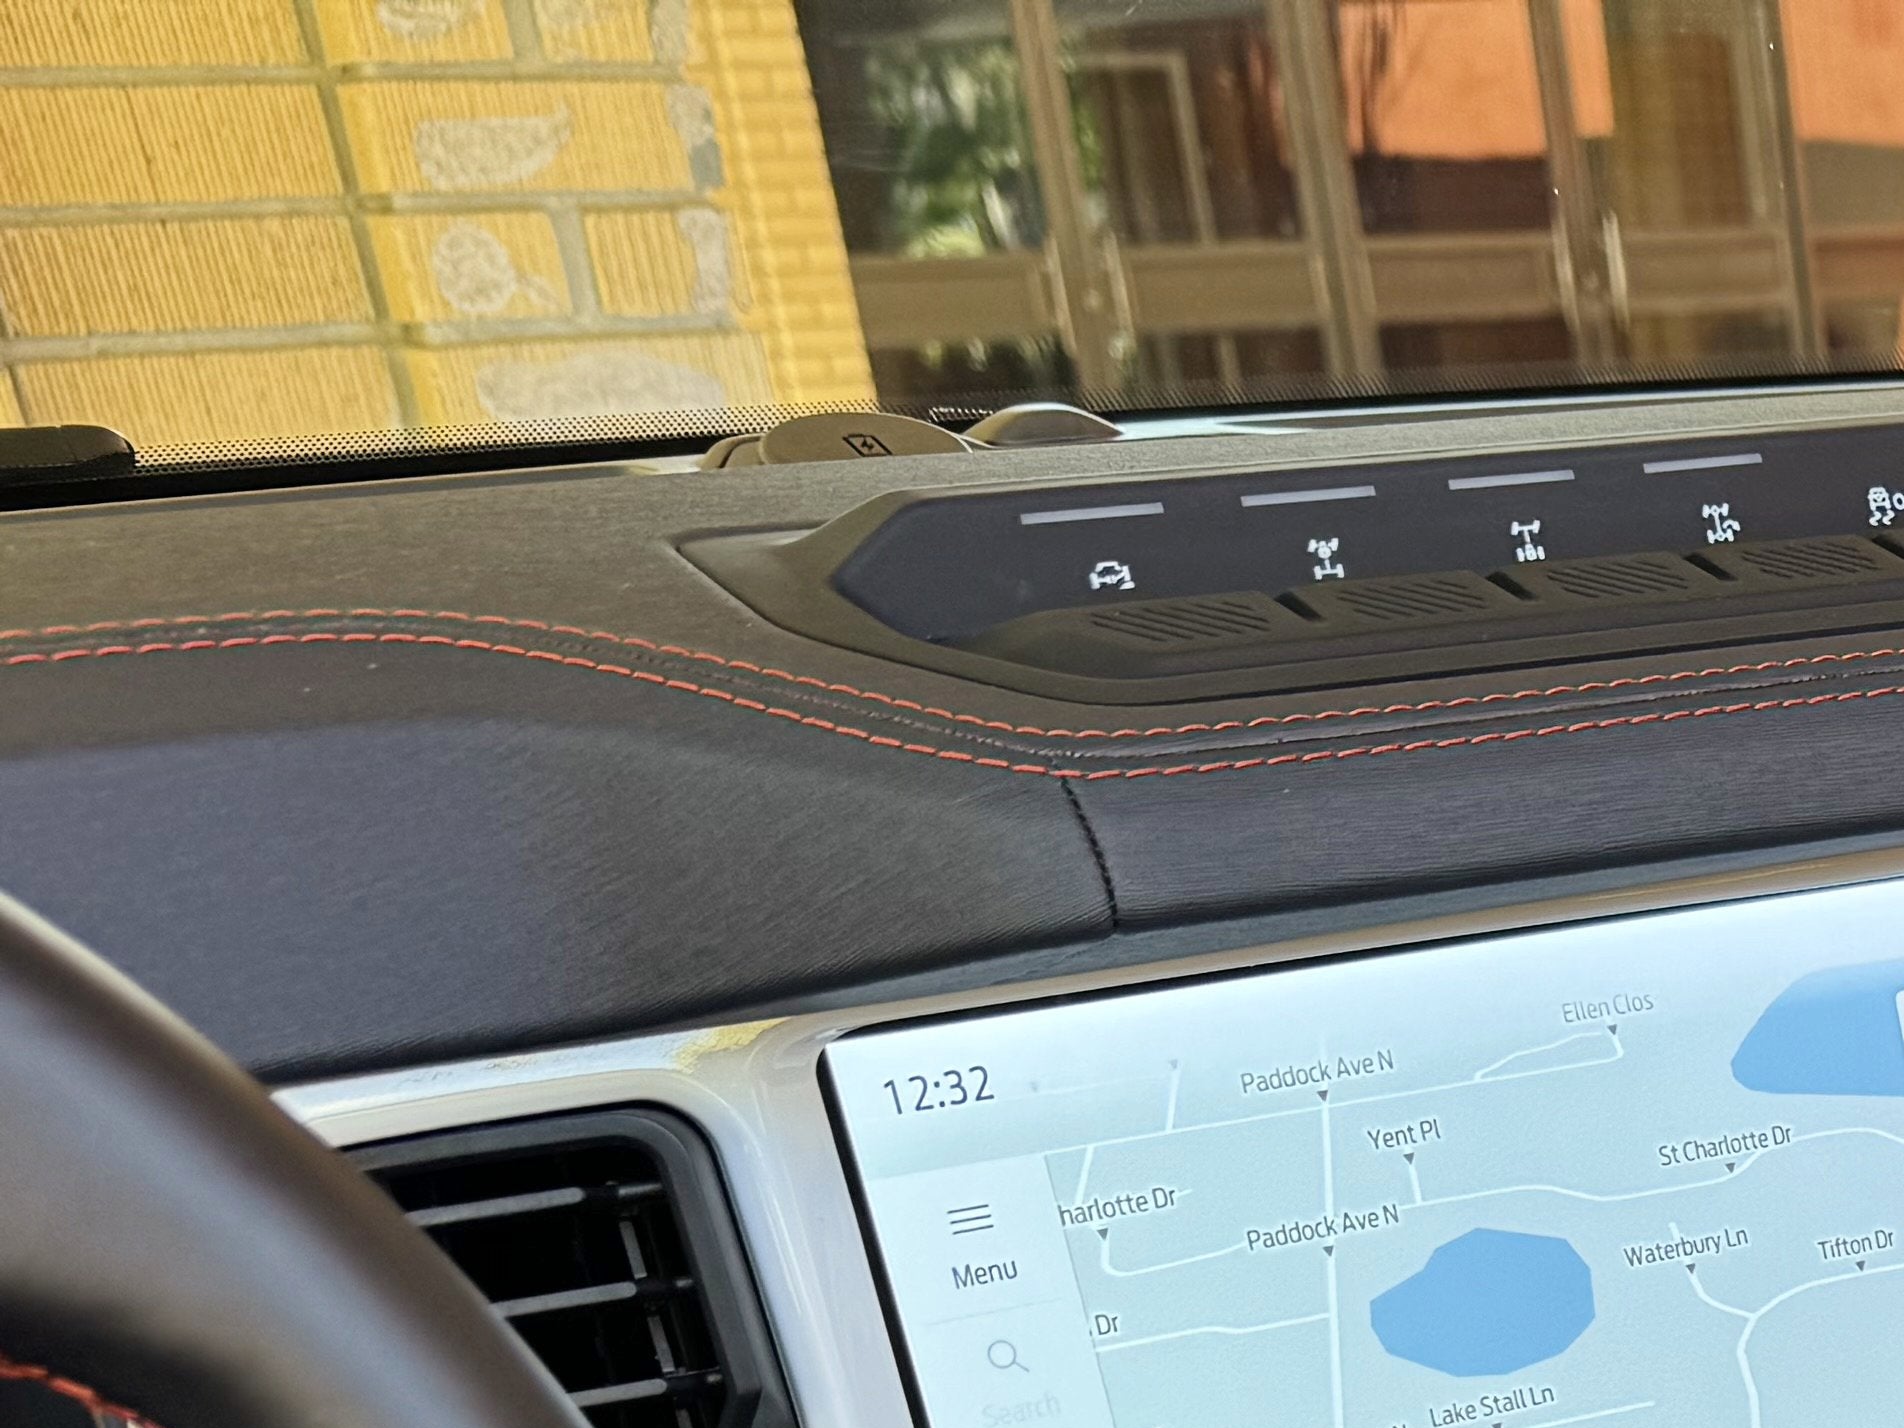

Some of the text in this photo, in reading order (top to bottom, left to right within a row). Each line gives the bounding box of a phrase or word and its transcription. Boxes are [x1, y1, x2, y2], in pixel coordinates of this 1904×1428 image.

[1562, 996, 1608, 1025] Ellen
[882, 1064, 996, 1117] 12:32
[1240, 1050, 1395, 1095] Paddock Ave N
[1367, 1119, 1442, 1151] Yent Pl
[1658, 1123, 1793, 1168] St Charlotte Dr
[1057, 1186, 1176, 1226] harlotte Dr
[1246, 1203, 1400, 1252] Paddock Ave N
[1817, 1227, 1896, 1260] Tifton Dr
[1623, 1226, 1750, 1271] Waterbury Ln
[952, 1257, 1019, 1291] Menu
[1094, 1313, 1119, 1336] Dr
[981, 1392, 1062, 1428] Search
[1480, 1390, 1527, 1419] Stall
[1529, 1384, 1555, 1408] Ln
